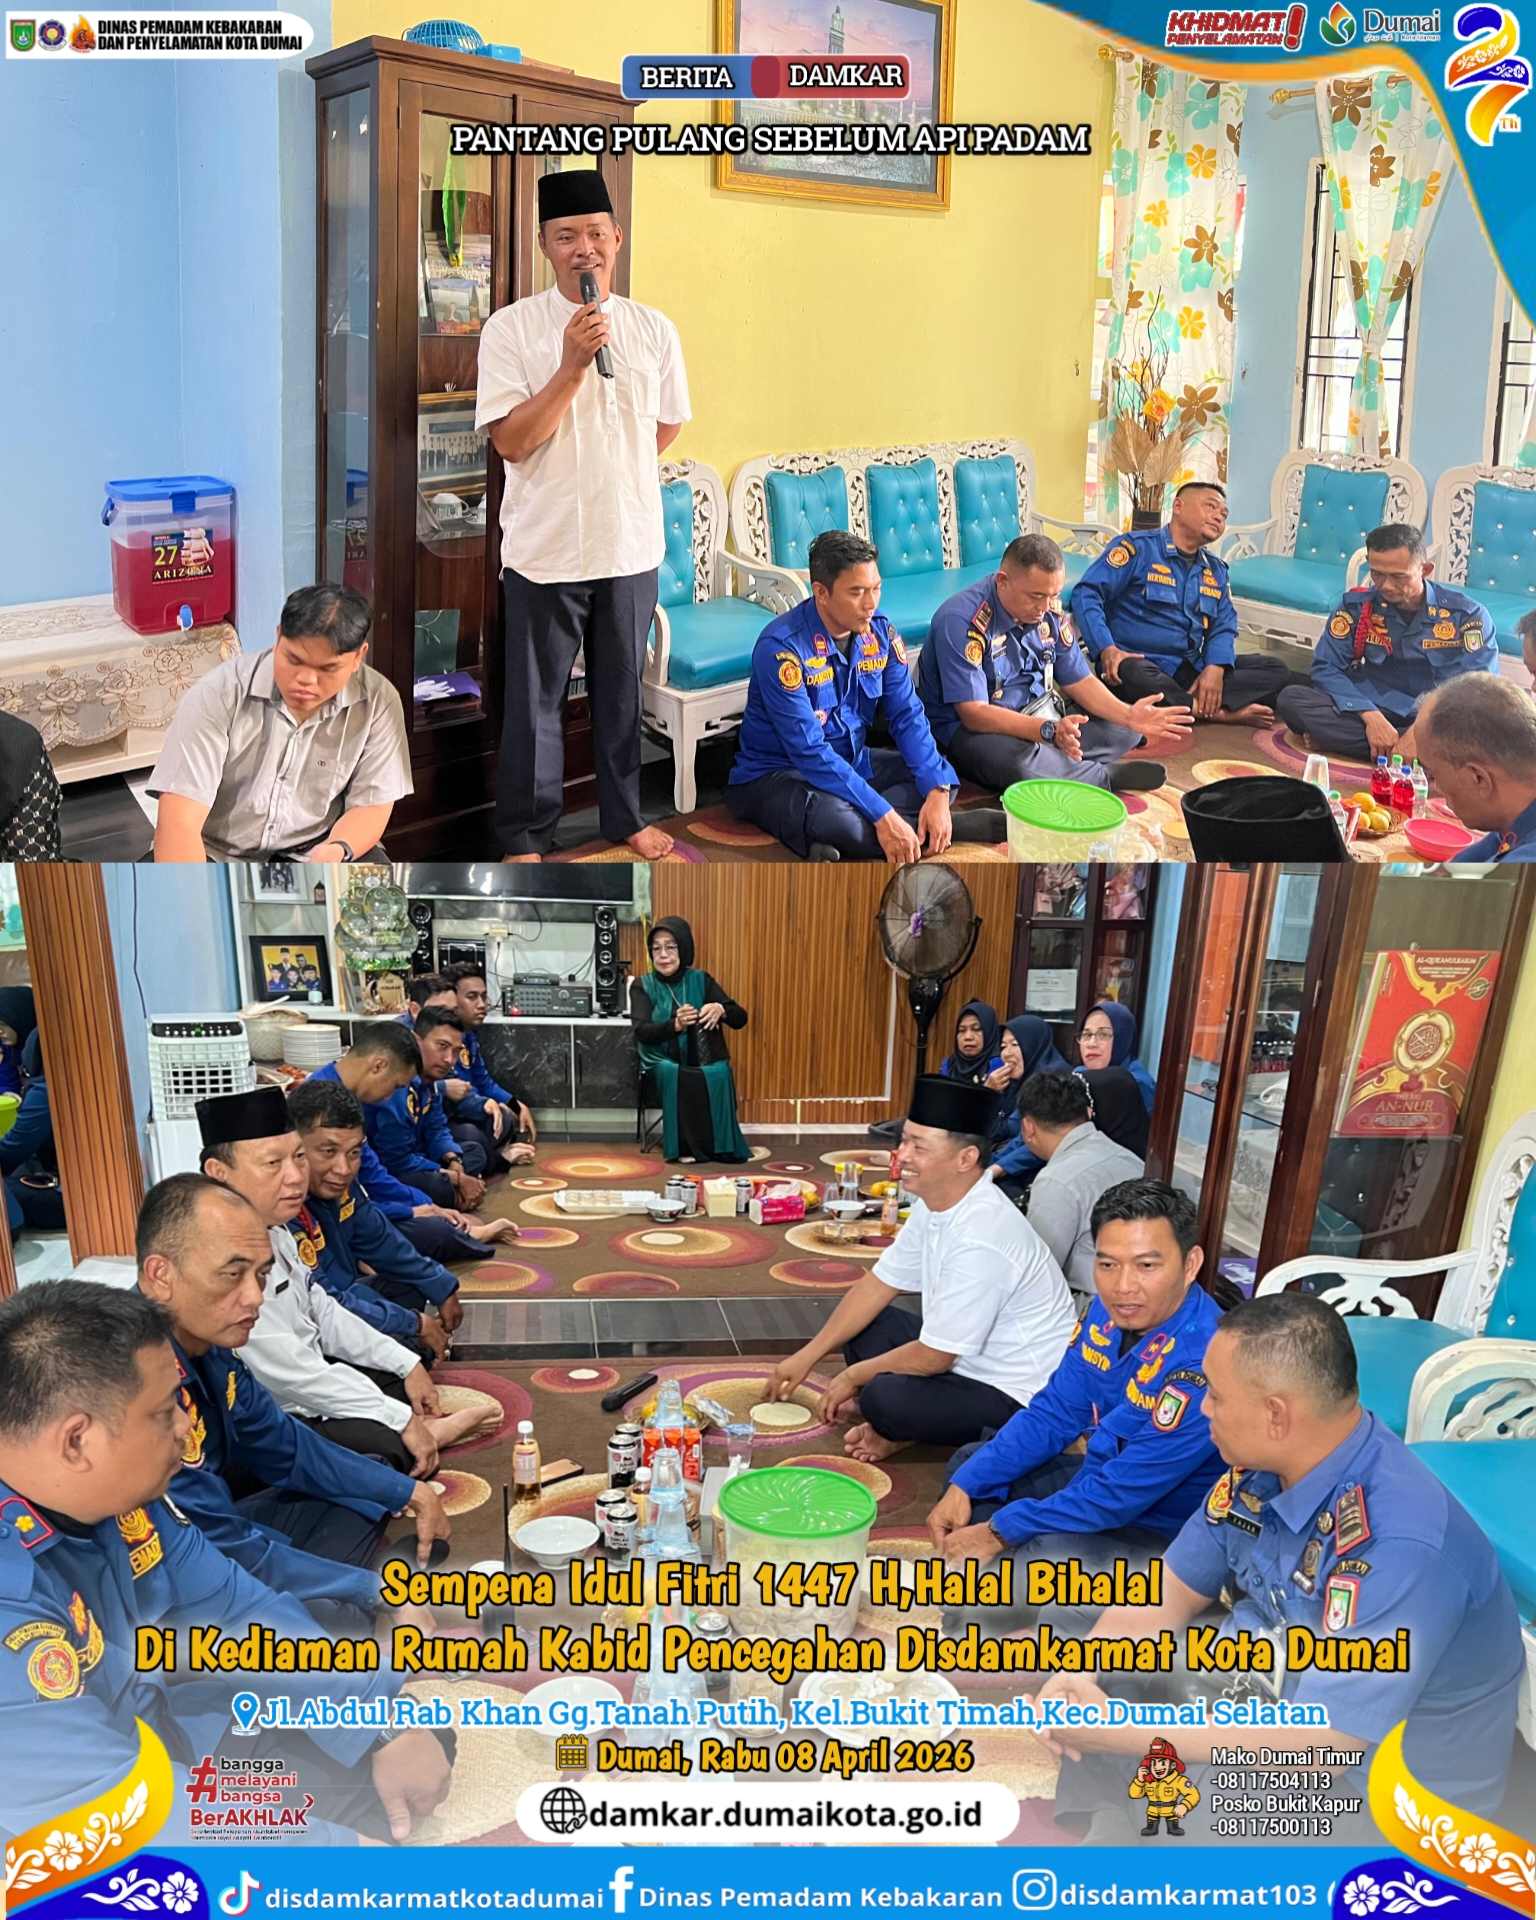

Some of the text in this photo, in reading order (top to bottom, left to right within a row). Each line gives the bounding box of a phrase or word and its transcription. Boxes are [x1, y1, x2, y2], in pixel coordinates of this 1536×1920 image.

[154, 545, 178, 566] 27
[154, 565, 212, 580] ARIZONA
[1374, 1100, 1434, 1112] AN-NUR
